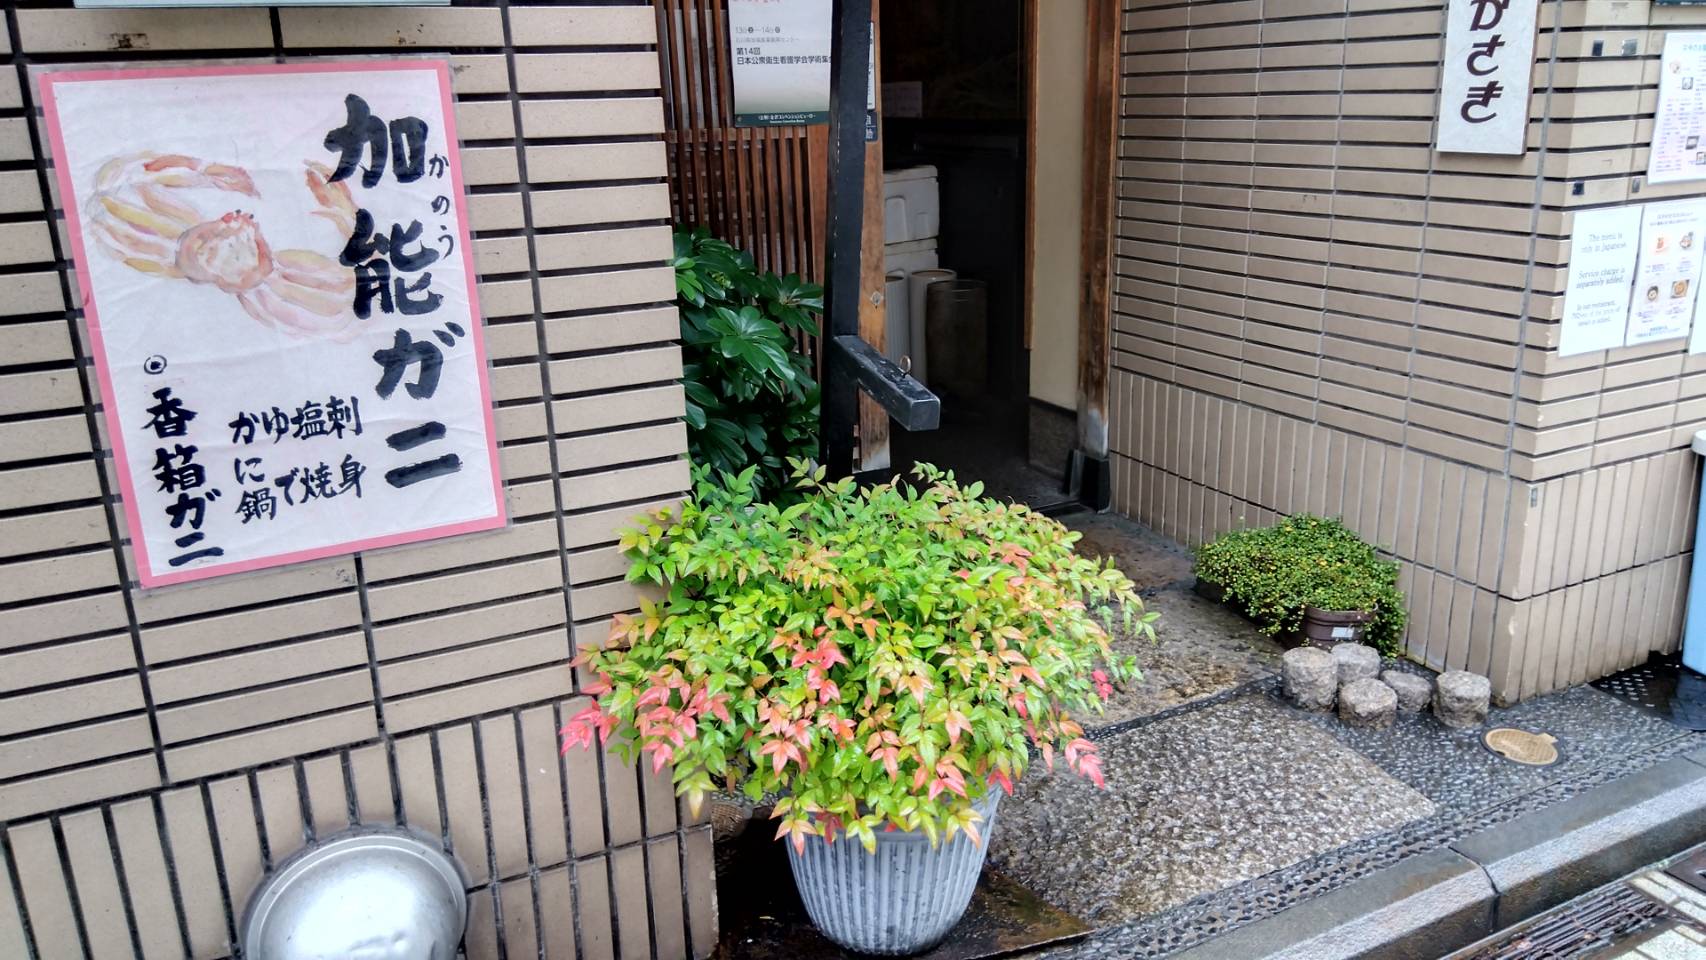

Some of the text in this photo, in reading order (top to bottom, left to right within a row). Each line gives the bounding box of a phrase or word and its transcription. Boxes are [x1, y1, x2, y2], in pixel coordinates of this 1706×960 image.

[736, 47, 761, 55] 第14回
[429, 154, 454, 260] かのう
